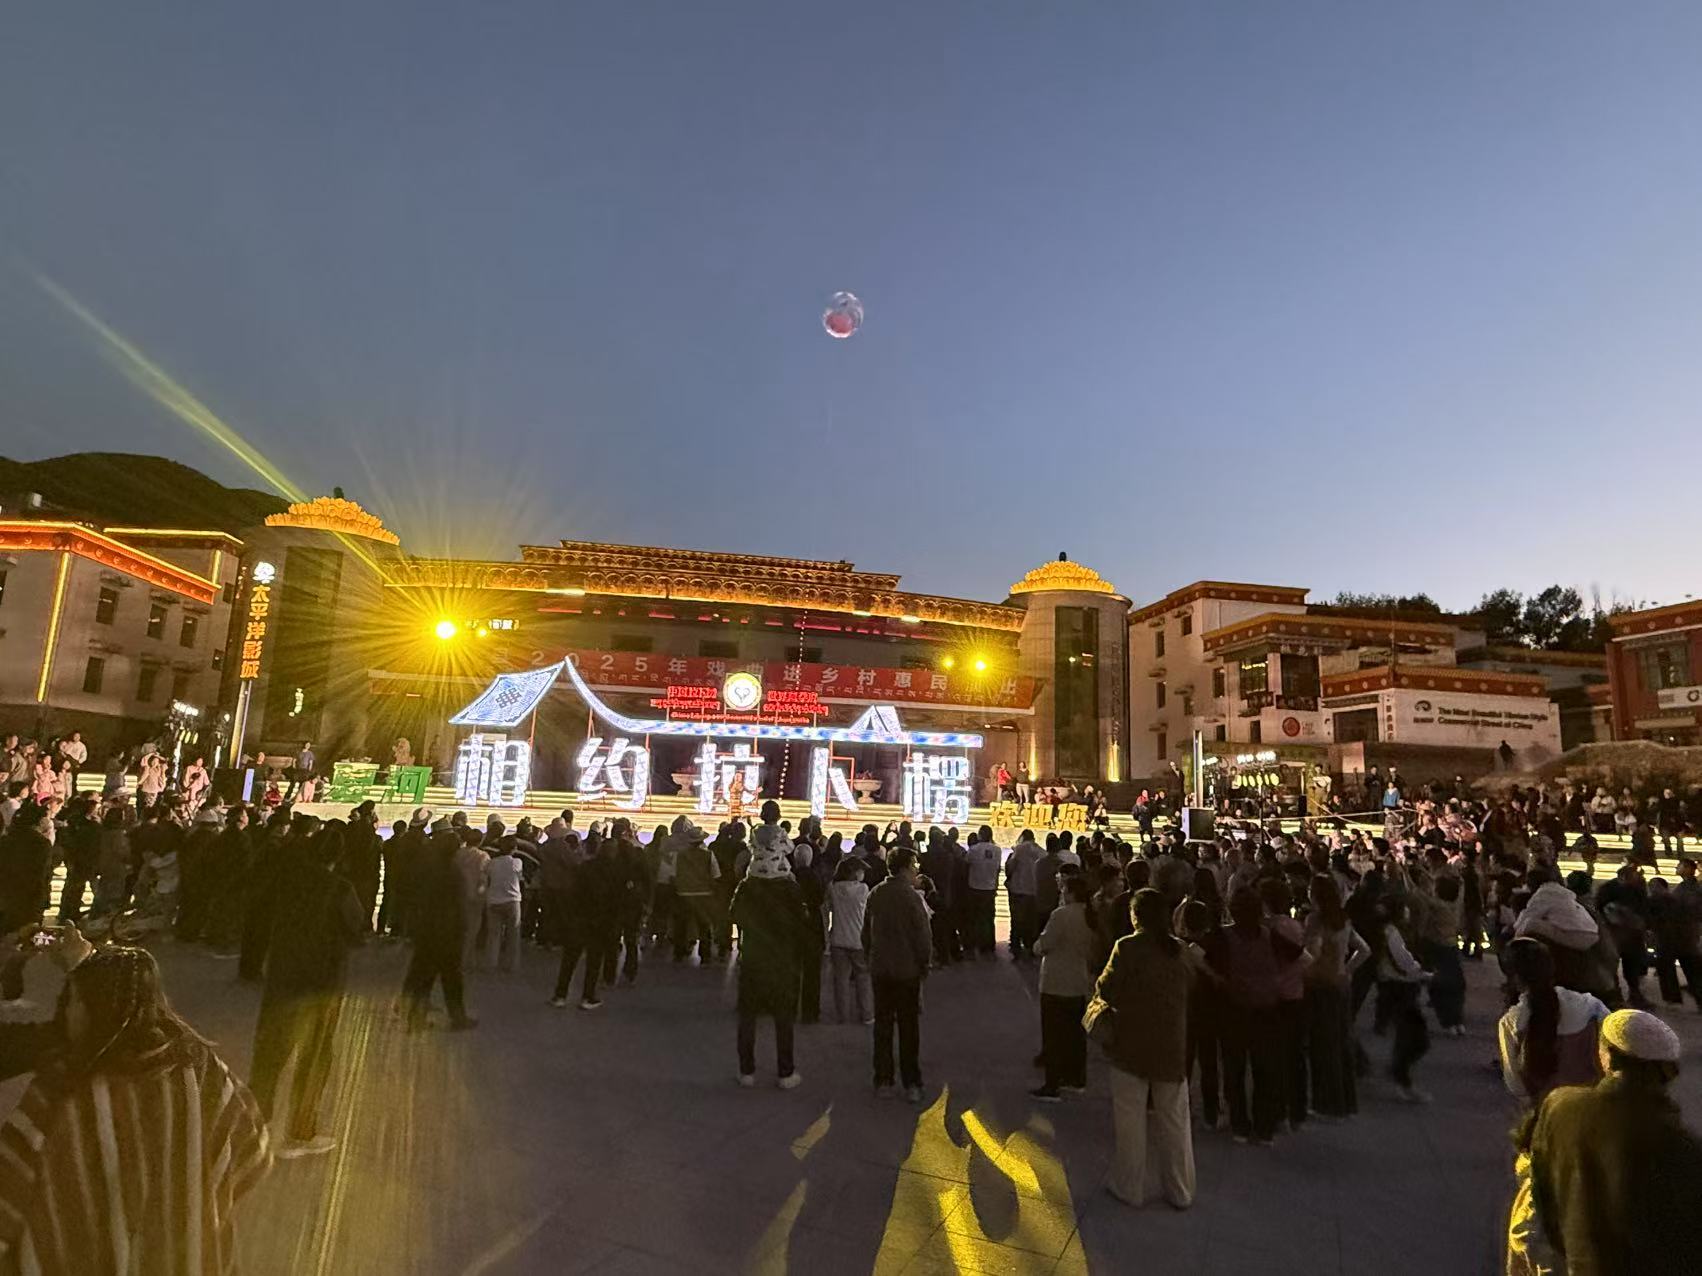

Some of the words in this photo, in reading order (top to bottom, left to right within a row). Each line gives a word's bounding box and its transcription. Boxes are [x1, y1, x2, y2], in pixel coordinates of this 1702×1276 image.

[240, 584, 271, 678] 太平洋影城
[1438, 716, 1480, 726] Commercial
[1480, 719, 1503, 728] Street
[1512, 721, 1533, 730] China
[1471, 709, 1502, 718] Beautiful
[455, 733, 972, 824] 相约拉卜楞
[990, 801, 1088, 832] 欢迎您
